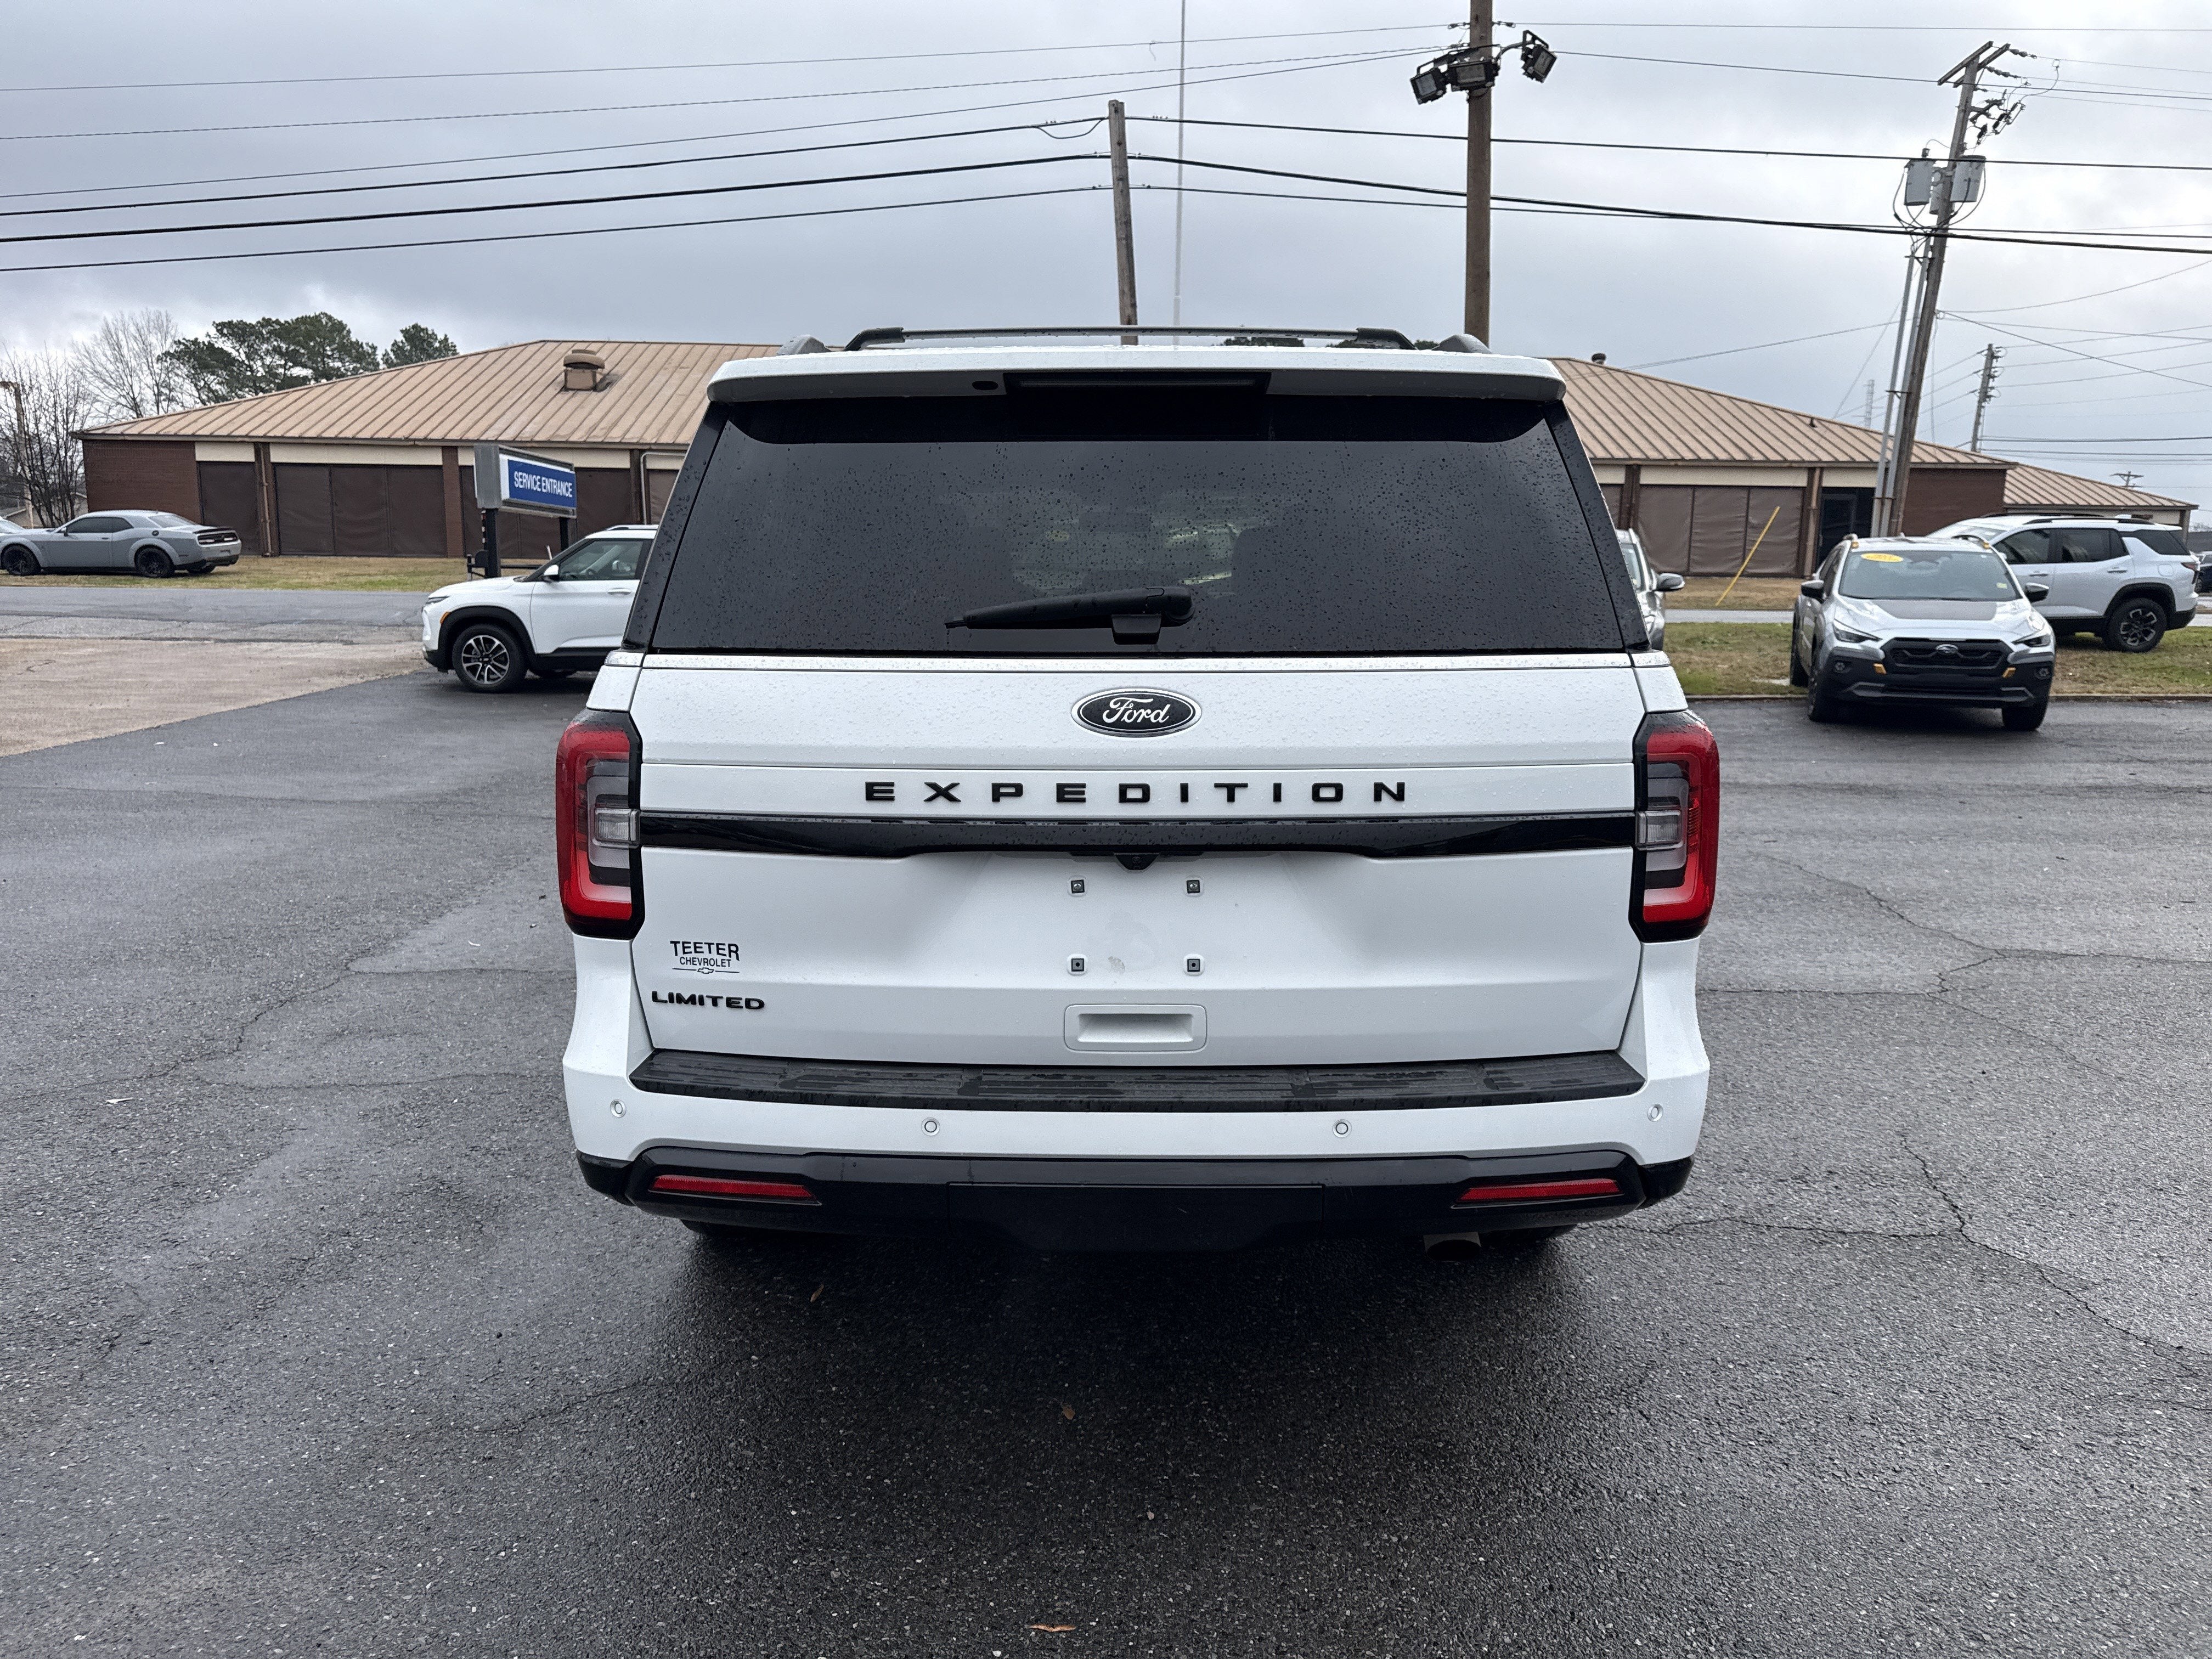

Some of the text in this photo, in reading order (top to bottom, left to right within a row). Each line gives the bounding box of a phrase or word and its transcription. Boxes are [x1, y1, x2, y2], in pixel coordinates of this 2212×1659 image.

[514, 471, 572, 498] SERVICE ENTRANCE
[1103, 697, 1171, 723] Ford
[865, 782, 1406, 803] EXPEDITION
[670, 940, 740, 961] TEETER
[680, 956, 731, 967] CHEVROLET
[652, 991, 765, 1009] LIMITED
